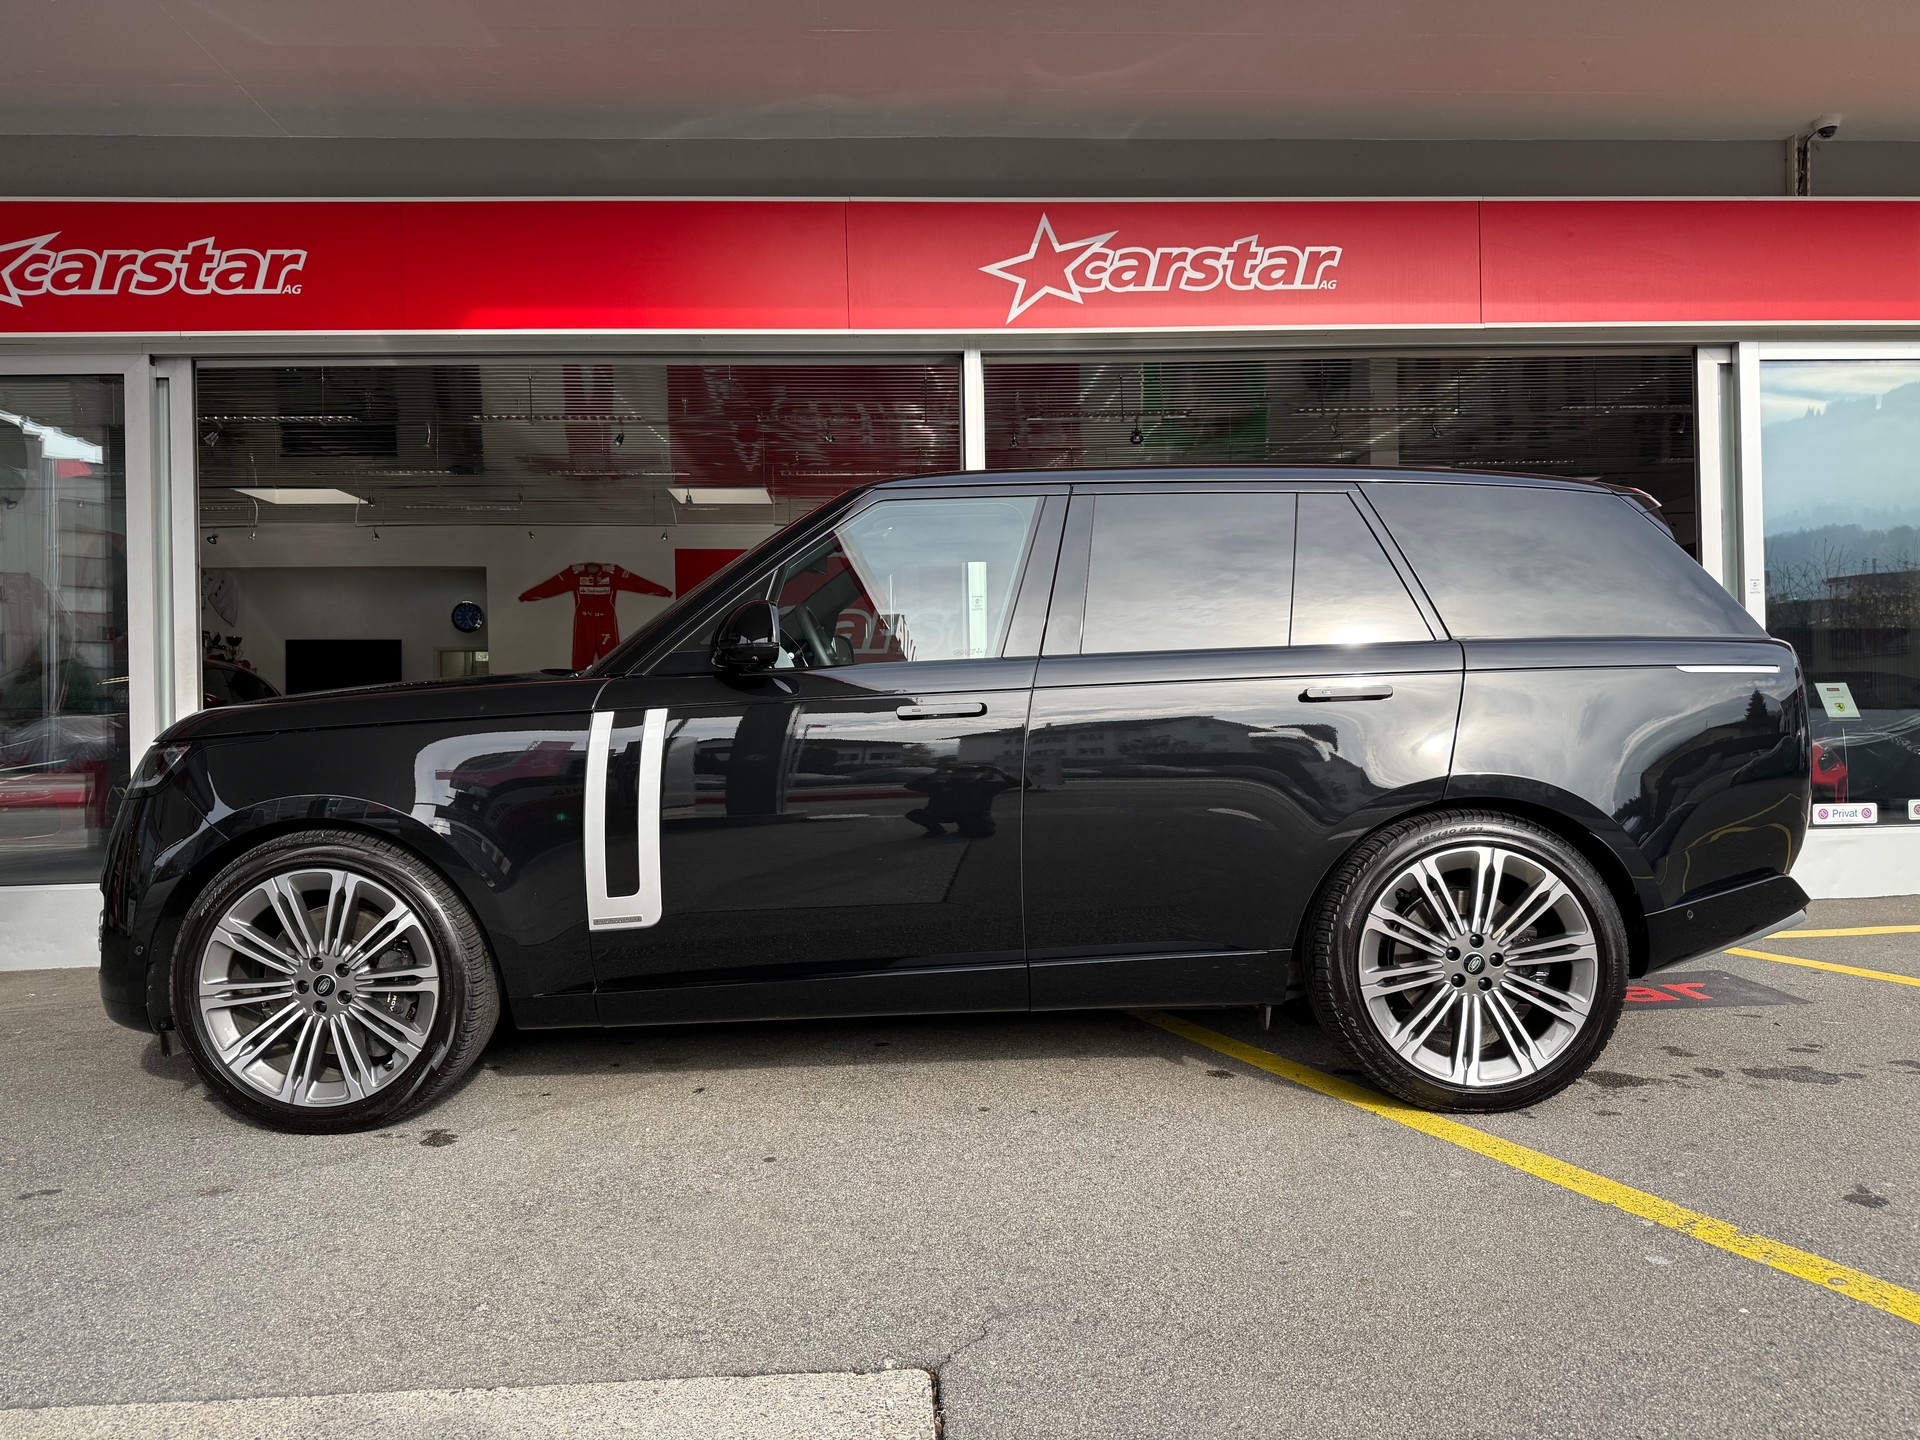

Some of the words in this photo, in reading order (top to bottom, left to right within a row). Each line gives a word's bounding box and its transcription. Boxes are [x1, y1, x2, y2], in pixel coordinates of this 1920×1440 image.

[11, 235, 308, 296] carstar
[281, 284, 303, 295] AG
[1070, 234, 1343, 293] carstar
[1318, 279, 1338, 290] AG
[602, 633, 612, 645] 7
[1831, 808, 1859, 818] Privat
